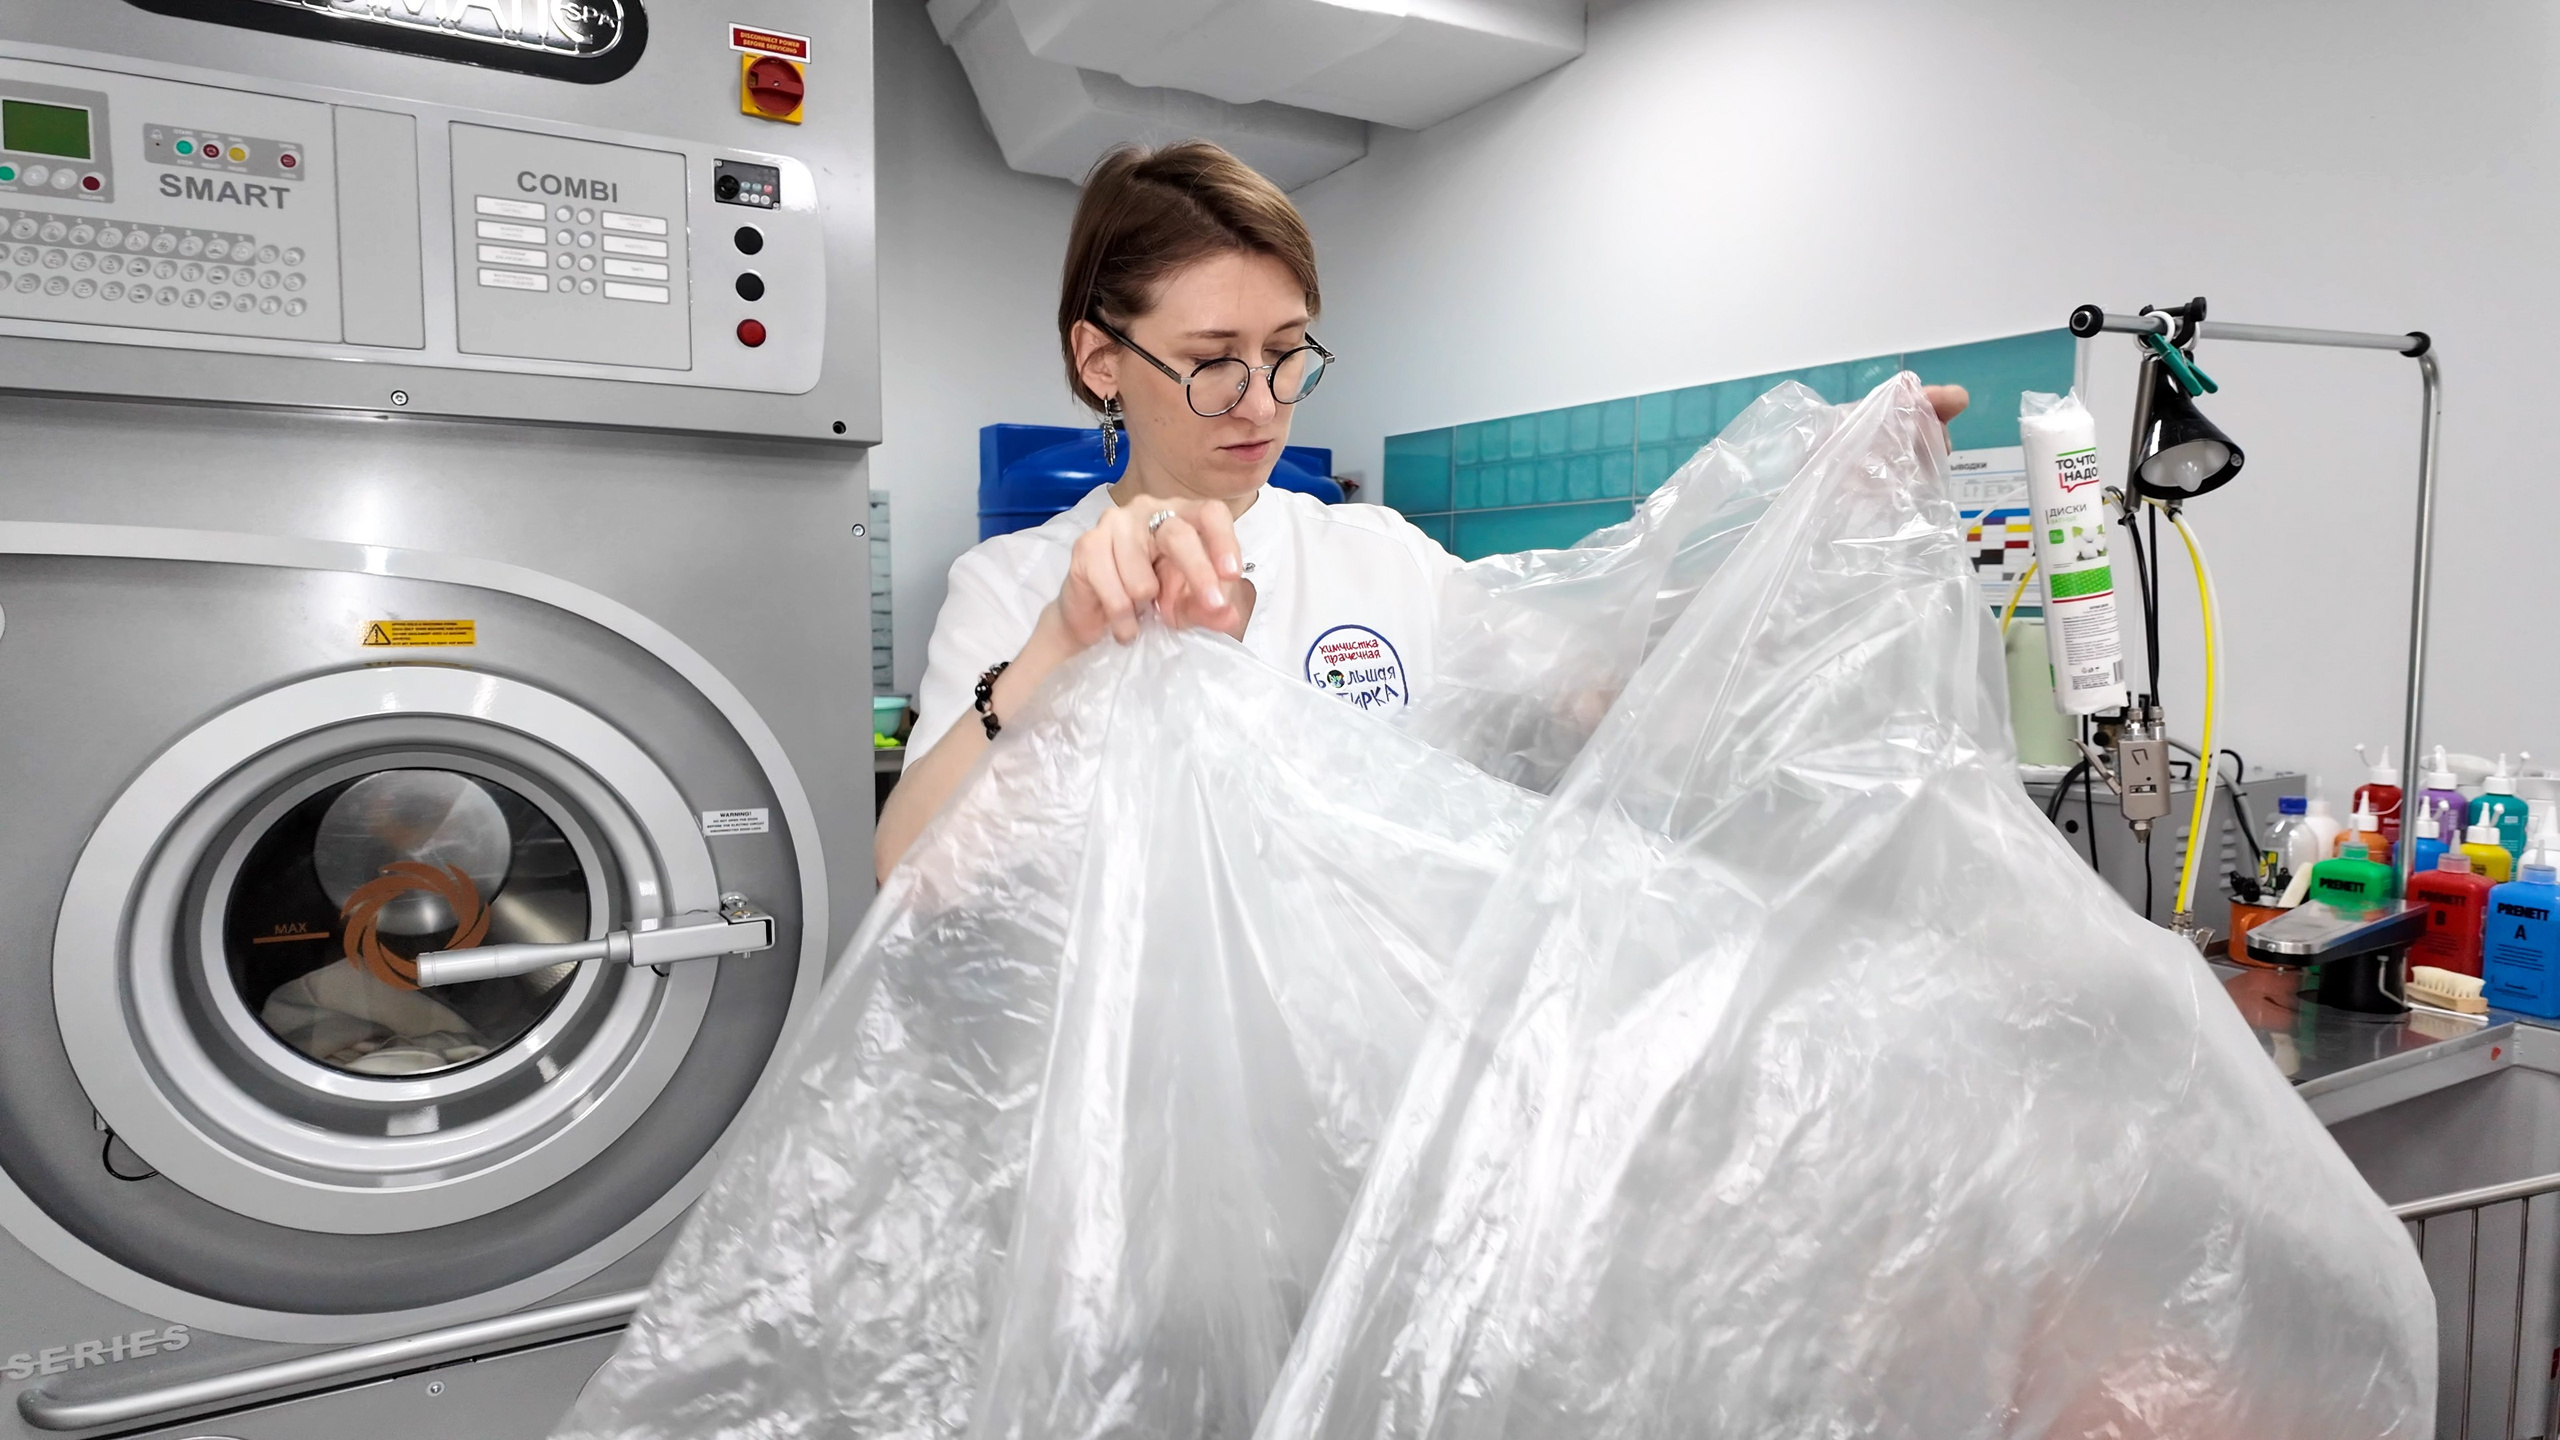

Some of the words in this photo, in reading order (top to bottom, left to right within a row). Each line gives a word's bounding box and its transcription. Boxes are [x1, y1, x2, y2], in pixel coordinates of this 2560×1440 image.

[564, 3, 616, 29] SPA
[740, 31, 778, 44] DISCONNECT
[779, 38, 800, 48] POWER
[743, 38, 766, 48] BEFORE
[766, 43, 798, 54] SERVICING
[159, 172, 291, 210] SMART
[517, 170, 618, 204] COMBI
[2049, 503, 2087, 518] ДИСКИ
[1319, 638, 1379, 654] химчистка
[1323, 649, 1382, 667] прачечная
[1335, 683, 1399, 711] ТИРКА
[2319, 877, 2365, 893] PRENETT
[2418, 890, 2467, 907] PRENETT
[2435, 910, 2446, 926] B
[2497, 902, 2550, 922] PRENETT
[275, 922, 307, 935] MAX
[2514, 924, 2527, 941] A
[7, 1324, 191, 1380] SERIES
